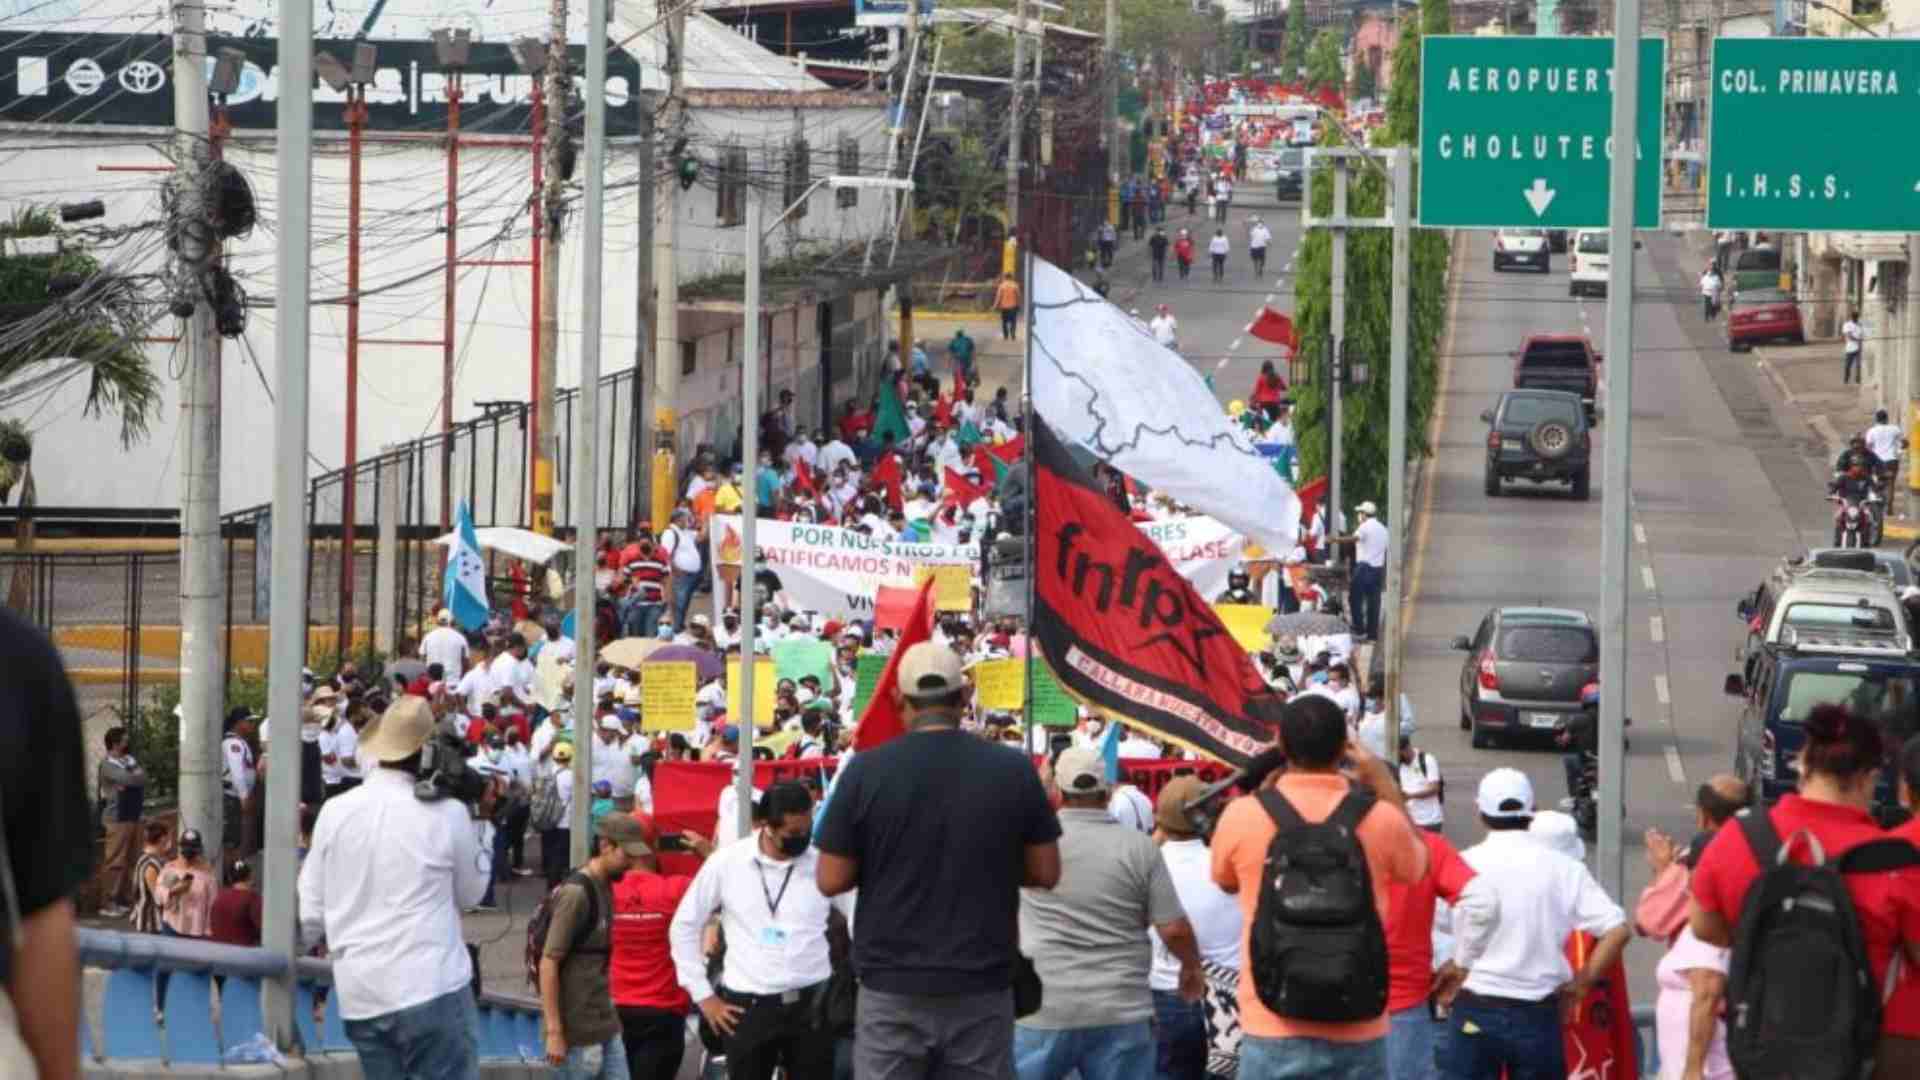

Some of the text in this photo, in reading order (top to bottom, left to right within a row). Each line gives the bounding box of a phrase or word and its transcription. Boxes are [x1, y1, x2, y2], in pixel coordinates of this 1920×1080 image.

[1447, 66, 1616, 92] AEROPUERT
[1721, 68, 1899, 95] COL. PRIMAVERA
[1725, 172, 1851, 199] I.H.S.S.
[791, 526, 834, 546] POR
[765, 544, 890, 576] ATIFICAMOS
